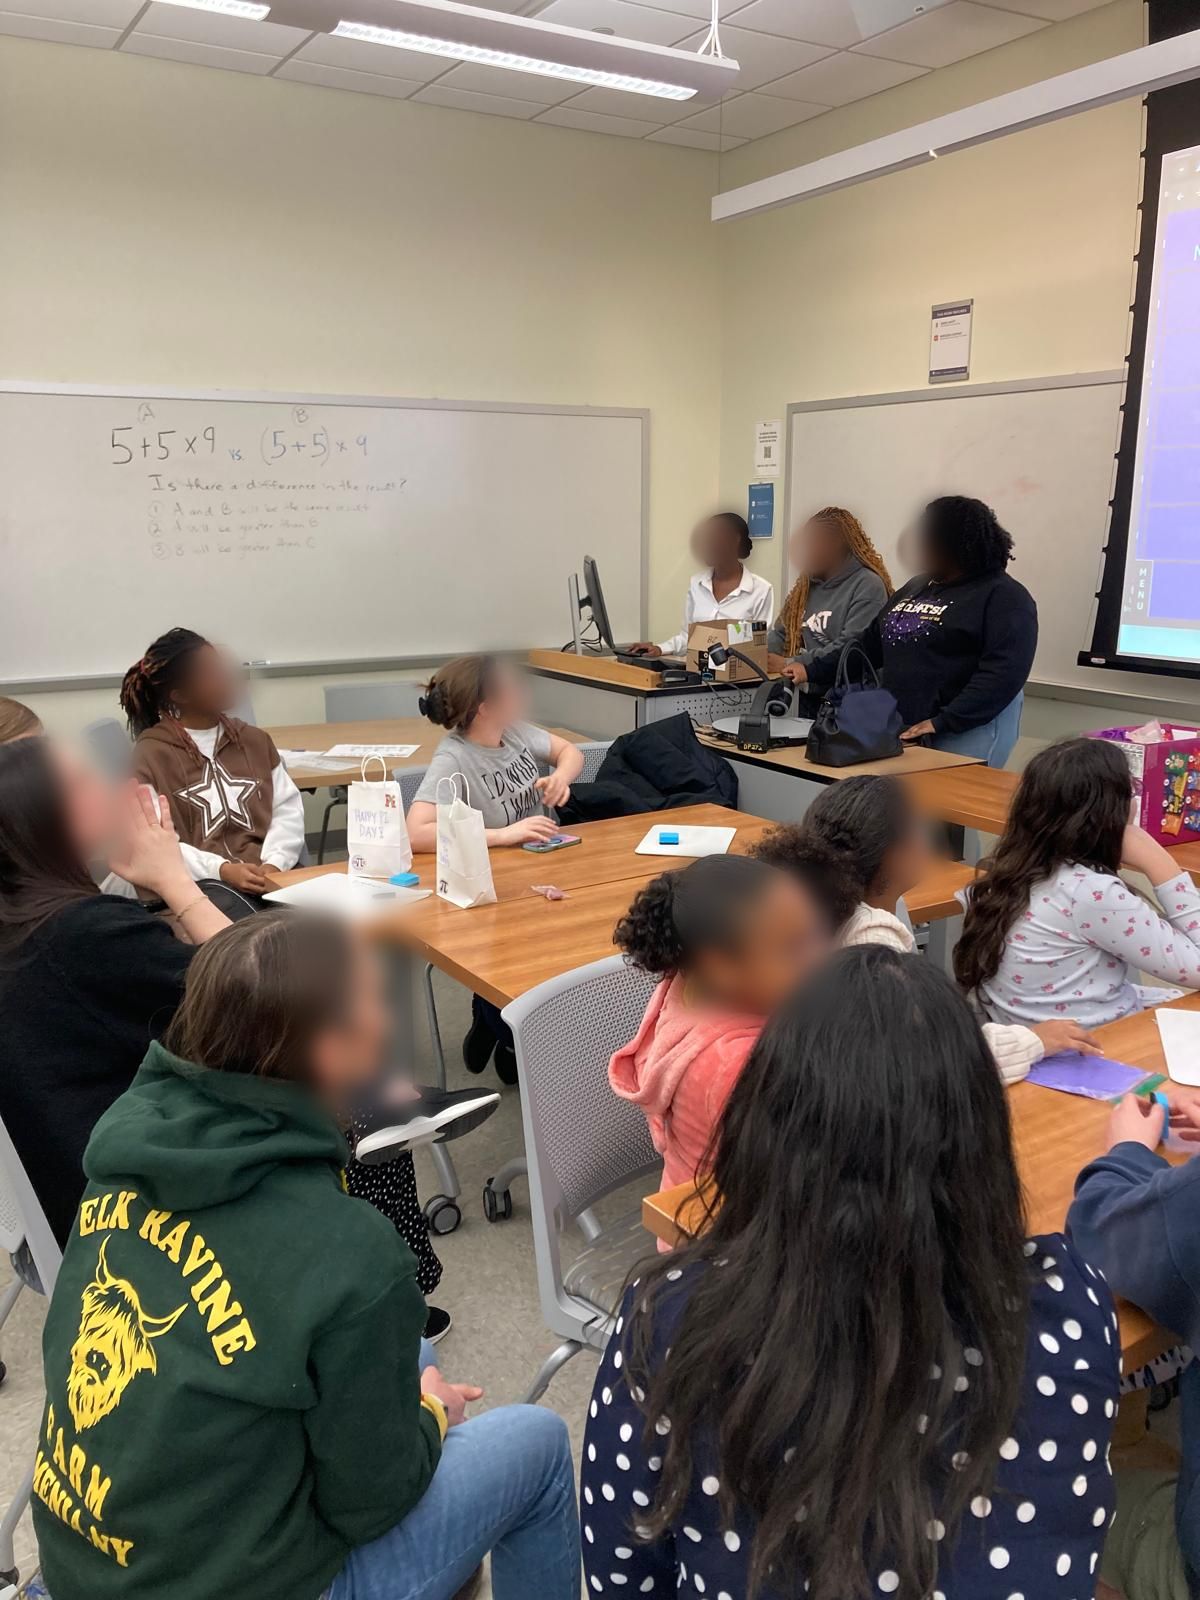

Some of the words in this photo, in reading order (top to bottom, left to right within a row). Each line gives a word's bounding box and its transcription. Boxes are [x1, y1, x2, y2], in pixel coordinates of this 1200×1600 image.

[148, 474, 177, 492] Is
[185, 478, 223, 491] there
[338, 479, 360, 492] the
[505, 747, 538, 789] WHAT
[354, 808, 377, 825] HAPPY
[79, 1190, 138, 1237] ELK
